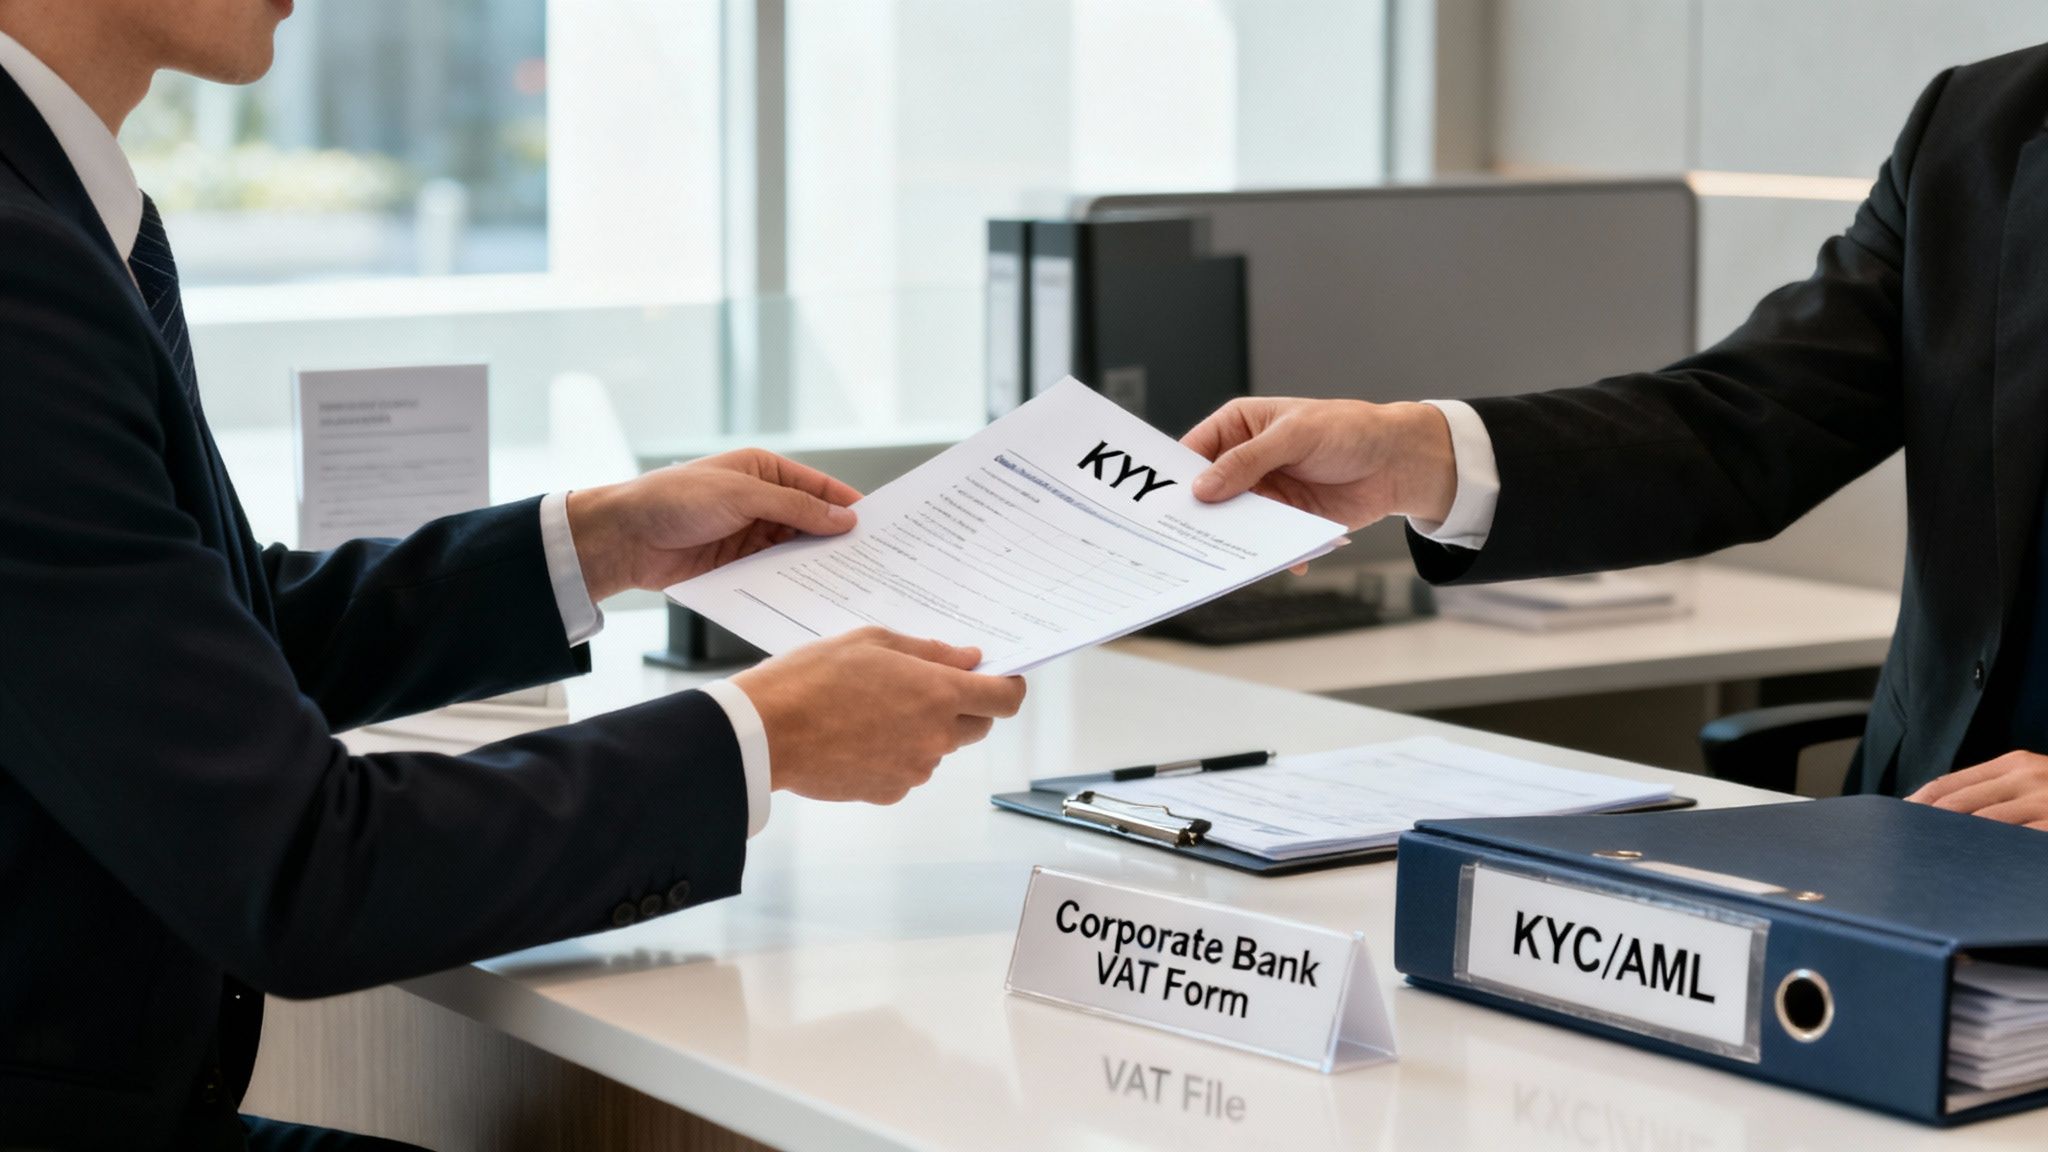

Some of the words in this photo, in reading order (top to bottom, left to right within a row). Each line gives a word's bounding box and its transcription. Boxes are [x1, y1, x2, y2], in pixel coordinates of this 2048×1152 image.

[1077, 440, 1178, 502] KYY
[1055, 899, 1224, 965] Corporate
[1231, 935, 1321, 987] Bank
[1512, 910, 1716, 1004] KYC/AML
[1096, 951, 1160, 994] VAT
[1162, 967, 1250, 1019] Form
[1102, 1055, 1173, 1103] VAT
[1181, 1072, 1247, 1122] File
